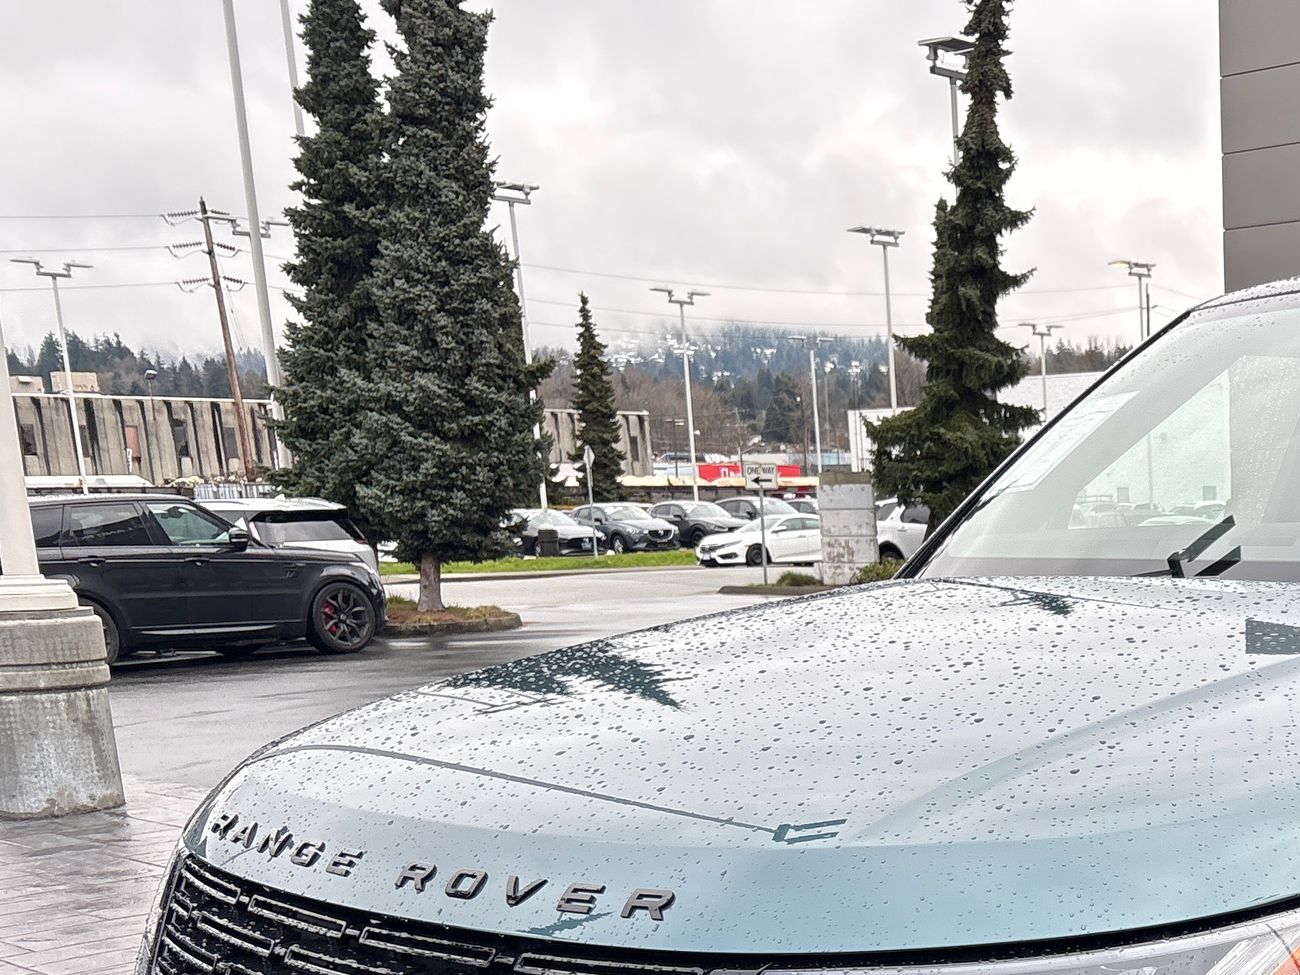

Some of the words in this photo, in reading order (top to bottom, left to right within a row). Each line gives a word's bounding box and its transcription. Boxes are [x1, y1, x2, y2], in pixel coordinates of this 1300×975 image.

[746, 466, 759, 476] ONE
[760, 465, 775, 475] WAY
[209, 812, 365, 878] RANGE
[394, 861, 677, 922] ROVER
